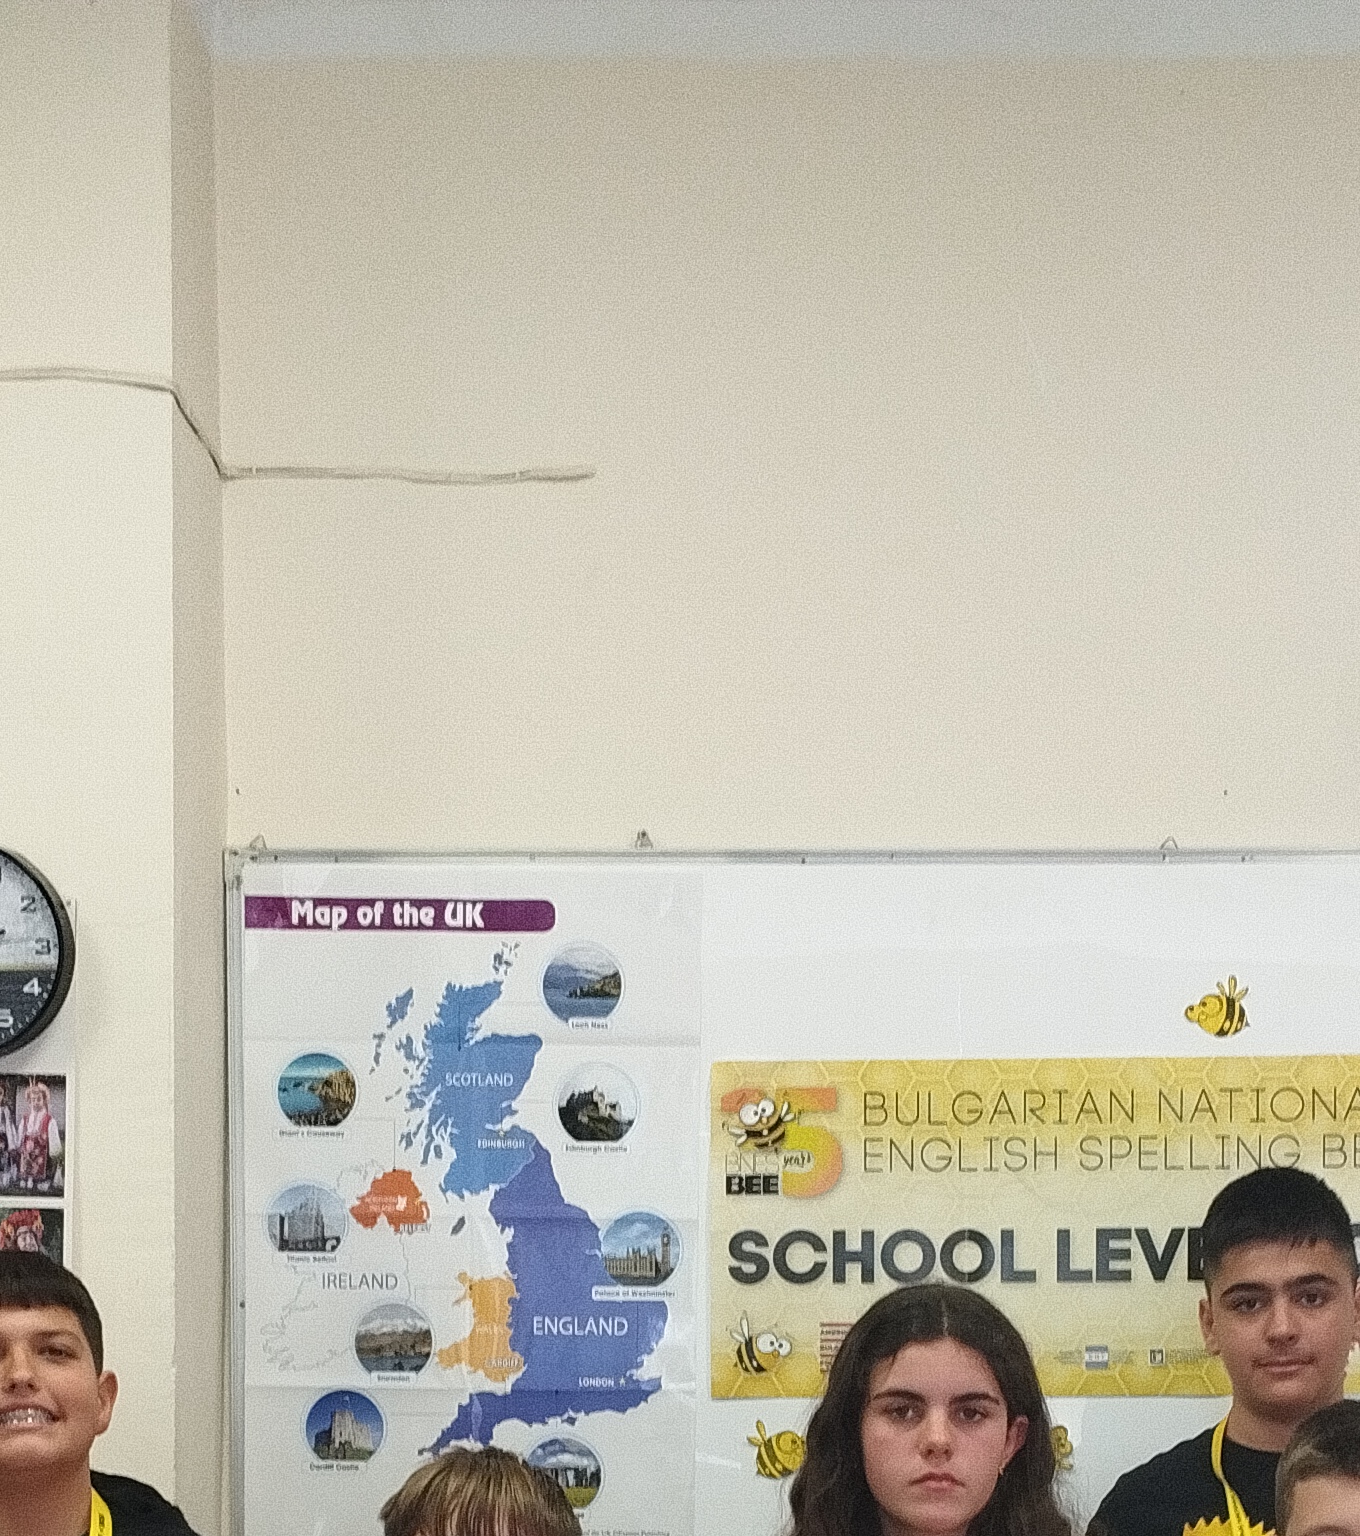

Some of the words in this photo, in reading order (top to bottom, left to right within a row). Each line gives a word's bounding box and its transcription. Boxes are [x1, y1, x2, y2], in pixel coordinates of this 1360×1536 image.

[20, 895, 37, 913] 2
[291, 900, 348, 931] Map
[356, 900, 385, 927] of
[393, 900, 435, 927] the
[444, 902, 485, 928] UK
[35, 937, 51, 955] 3
[23, 976, 42, 997] 4
[445, 1072, 514, 1088] SCOTLAND
[862, 1089, 1135, 1127] BULGARIAN
[863, 1136, 1059, 1174] ENGLISH
[1079, 1134, 1302, 1171] SPELLING
[726, 1175, 779, 1196] BEE
[726, 1229, 1036, 1284] SCHOOL
[1058, 1226, 1206, 1283] LEVE
[321, 1272, 399, 1291] IRELAND
[532, 1316, 629, 1337] ENGLAND
[579, 1377, 615, 1387] LONDON
